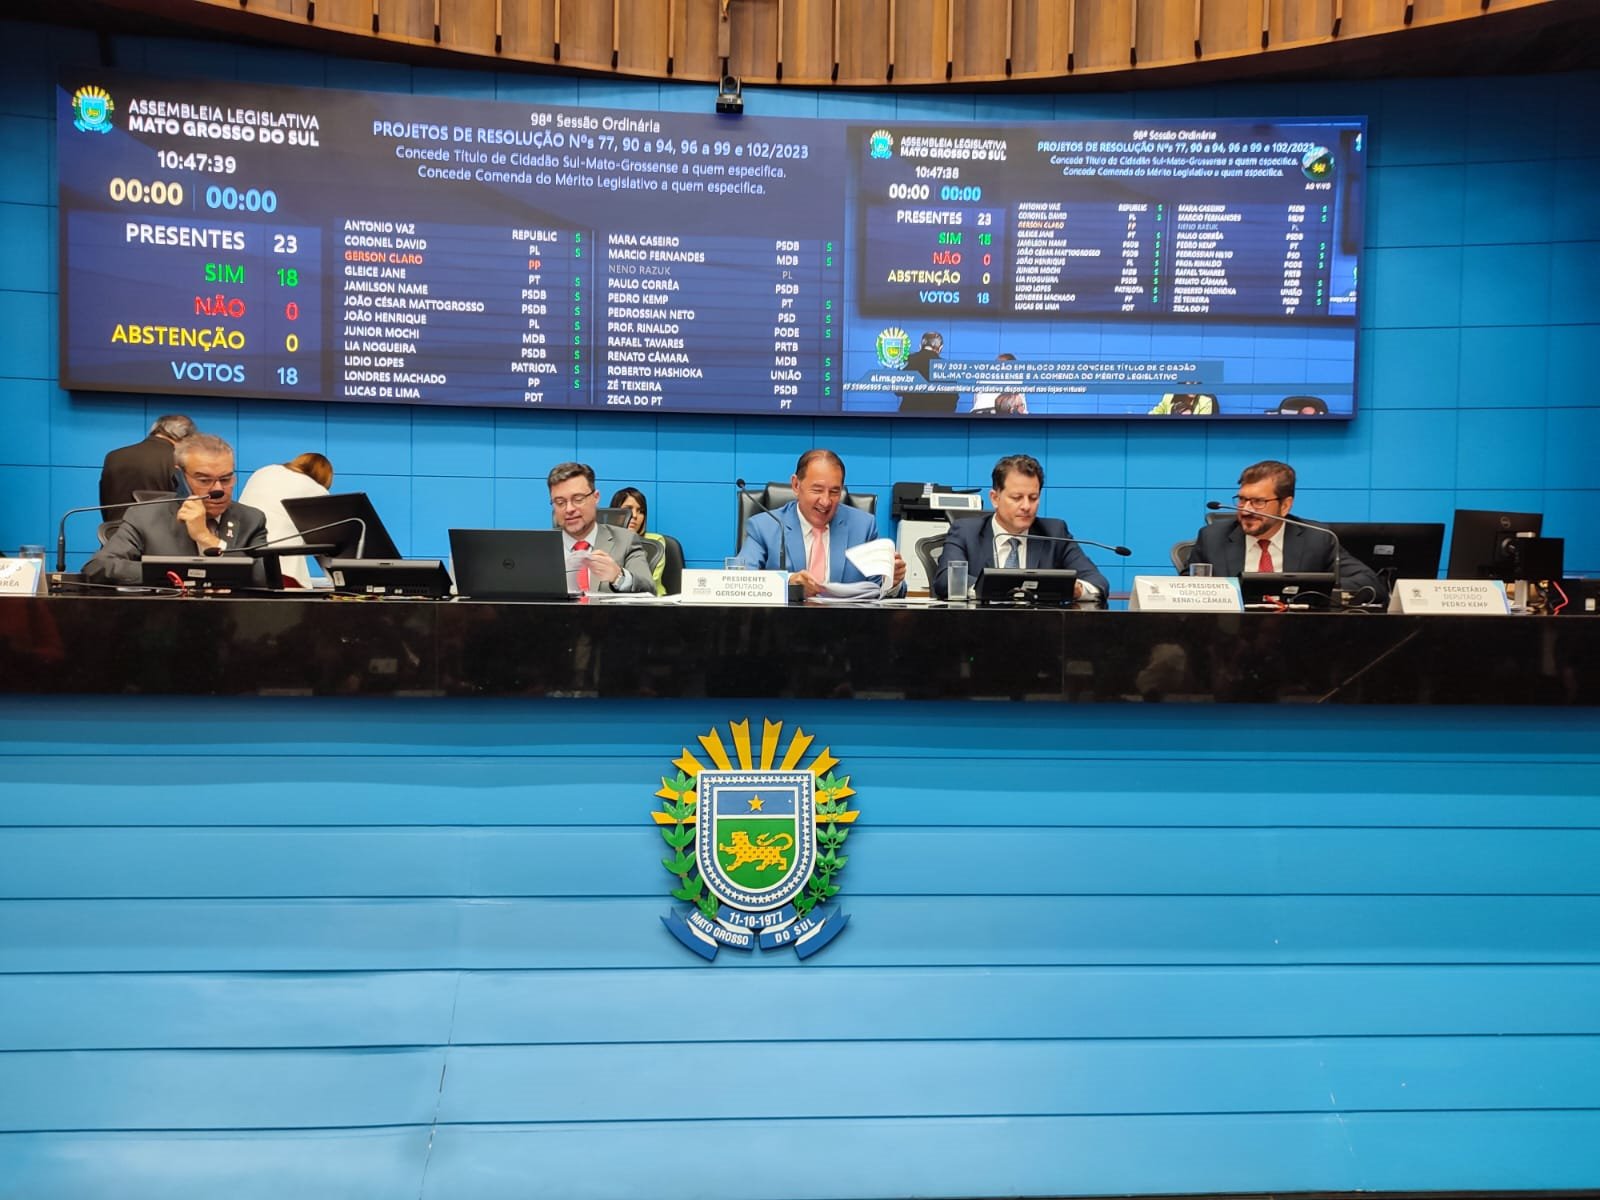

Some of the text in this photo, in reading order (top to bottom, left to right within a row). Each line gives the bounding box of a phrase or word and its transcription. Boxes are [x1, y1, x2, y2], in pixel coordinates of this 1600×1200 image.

[128, 99, 319, 130] ASSEMBLEIA LEGISLATIVA
[531, 112, 660, 133] 98ª Sessão Ordinária
[129, 116, 319, 146] MATO GROSSO DO SUL
[374, 121, 448, 141] PROJETOS
[453, 127, 472, 142] DE
[478, 129, 564, 149] RESOLUÇÃO
[598, 136, 618, 152] 77,
[622, 137, 639, 152] 90
[644, 142, 651, 152] a
[656, 139, 676, 155] 94,
[681, 140, 697, 154] 96
[702, 144, 709, 155] a
[714, 141, 730, 156] 99
[735, 146, 743, 156] e
[747, 143, 808, 160] 102/2023
[901, 136, 1006, 150] ASSEMBLEIA LEGISLATIVA
[901, 147, 1006, 161] MATO GROSSO DO SUL
[157, 150, 236, 174] 10:47:39
[396, 146, 786, 179] Concede Título de Cidadão Sul-Mato-Grossense a quem especifica.
[418, 165, 766, 195] Concede Comenda do Mérito Legislativo a quem especifica.
[110, 177, 183, 206] 00:00
[889, 184, 929, 200] 00:00
[941, 186, 981, 201] 00:00
[206, 185, 277, 213] 00:00
[897, 210, 991, 225] PRESENTES 23
[345, 220, 415, 234] ANTONIO VAZ
[126, 223, 297, 253] PRESENTES 23
[512, 229, 557, 242] REPUBLIC
[608, 234, 679, 247] MARA CASEIRO
[939, 232, 991, 245] SIM 18
[345, 235, 427, 250] CORONEL DAVID
[529, 245, 540, 255] PL
[608, 249, 704, 262] MARCIO FERNANDES
[345, 250, 423, 264] GERSON CLARO
[933, 252, 990, 265] NÃO 0
[529, 260, 540, 270] PP
[608, 265, 670, 276] NENO RAZUK
[205, 263, 298, 287] SIM 18
[345, 266, 405, 279] GLEICE JANE
[888, 269, 990, 286] ABSTENÇÃO 0
[529, 275, 540, 285] PT
[608, 278, 679, 291] PAULO CORRÊA
[344, 280, 428, 295] JAMILSON NAME
[522, 289, 546, 300] PSDB
[608, 293, 668, 304] PEDRO KEMP
[920, 291, 989, 304] VOTOS 18
[195, 294, 298, 320] NÃO 0
[344, 295, 484, 310] JOÃO CÉSAR MATTOGROSSO
[522, 304, 546, 314] PSDB
[344, 310, 427, 325] JOÃO HENRIQUE
[608, 308, 695, 320] PEDROSSIAN NETO
[529, 319, 539, 329] PL
[608, 323, 679, 334] PROF. RINALDO
[111, 324, 298, 352] ABSTENÇÃO 0
[344, 326, 419, 339] JUNIOR MOCHI
[523, 333, 545, 343] MDB
[345, 341, 416, 353] LIA NOGUEIRA
[608, 337, 684, 349] RAFAEL TAVARES
[522, 348, 546, 358] PSDB
[608, 351, 689, 363] RENATO CÂMARA
[345, 356, 404, 367] LIDIO LOPES
[512, 362, 557, 373] PATRIOTA
[171, 361, 298, 385] VOTOS 18
[345, 371, 446, 384] LONDRES MACHADO
[608, 366, 703, 378] ROBERTO HASHIOKA
[528, 378, 540, 387] PP
[607, 379, 661, 392] ZÉ TEIXEIRA
[345, 386, 420, 398] LUCAS DE LIMA
[525, 392, 543, 402] PDT
[607, 395, 662, 406] ZECA DO PT
[730, 912, 783, 927] 11-10-1977
[690, 912, 815, 946] MATO GROSSO DO SUL
